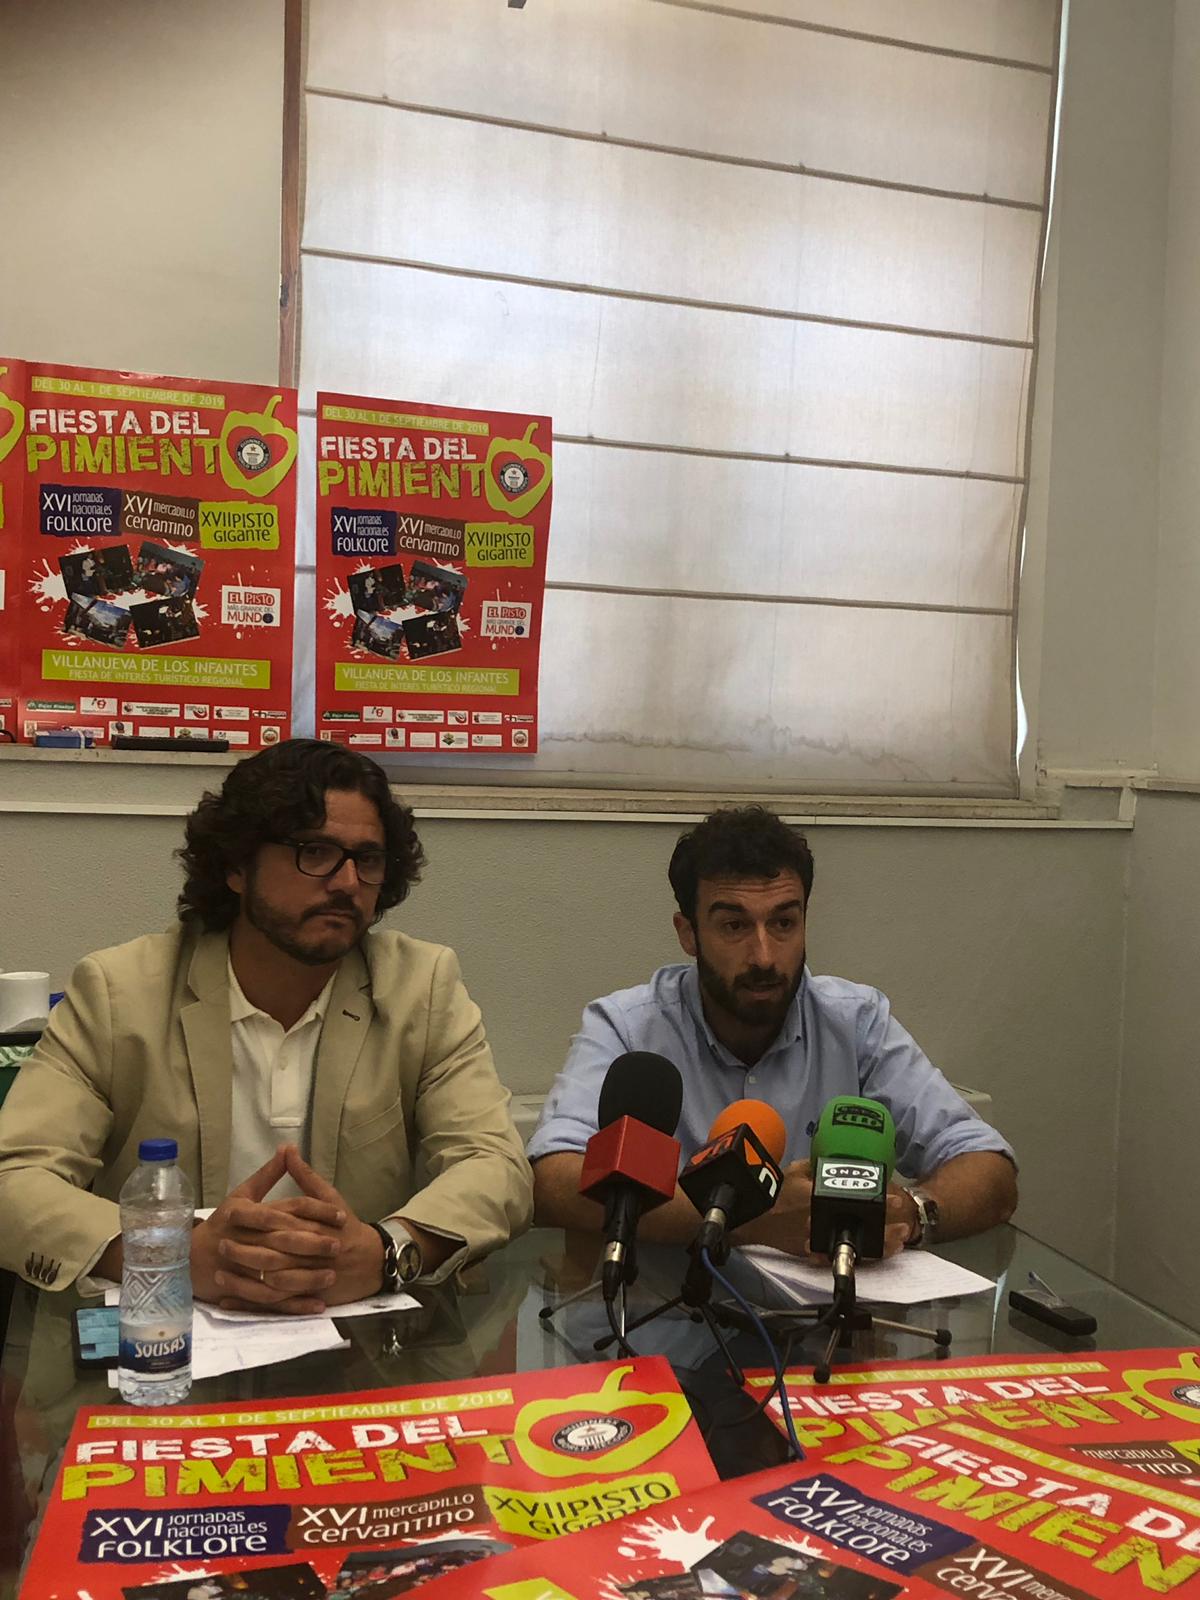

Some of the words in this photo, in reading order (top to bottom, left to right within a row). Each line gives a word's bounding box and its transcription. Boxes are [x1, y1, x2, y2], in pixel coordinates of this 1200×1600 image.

[117, 386, 178, 402] SEPTIEMBRE
[199, 395, 225, 407] 2019
[29, 409, 143, 435] FIESTA
[150, 410, 210, 436] DEL
[320, 436, 416, 460] FIESTA
[423, 437, 477, 460] DEL
[42, 491, 71, 512] XVI
[123, 493, 153, 516] XVI
[333, 514, 357, 534] XVI
[399, 515, 425, 536] XVI
[228, 592, 242, 604] EL
[487, 606, 500, 618] EL
[51, 654, 138, 671] VILLANUEVA
[141, 658, 159, 672] DE
[164, 660, 190, 674] LOS
[194, 662, 258, 677] INFANTES
[342, 667, 409, 681] VILLANUEVA
[412, 669, 427, 682] DE
[430, 670, 452, 683] LOS
[456, 671, 510, 685] INFANTES
[827, 1167, 873, 1179] ONDA
[830, 1178, 872, 1189] CERO
[134, 1335, 186, 1359] SOUSAS
[768, 1385, 989, 1416] FIESTA
[984, 1376, 1111, 1400] DEL
[95, 1416, 136, 1427] DEL
[147, 1417, 173, 1427] 30
[179, 1416, 208, 1427] AL
[237, 1413, 267, 1424] DE
[275, 1402, 413, 1421] SEPTIEMBRE
[421, 1400, 448, 1412] DE
[458, 1391, 509, 1409] 2019
[76, 1429, 337, 1463] FIESTA
[350, 1414, 488, 1450] DEL
[885, 1433, 1113, 1518] FIESTA
[791, 1479, 865, 1516] XVI
[90, 1516, 164, 1537] XVI
[297, 1506, 368, 1527] XVI
[953, 1548, 1035, 1589] XVI
